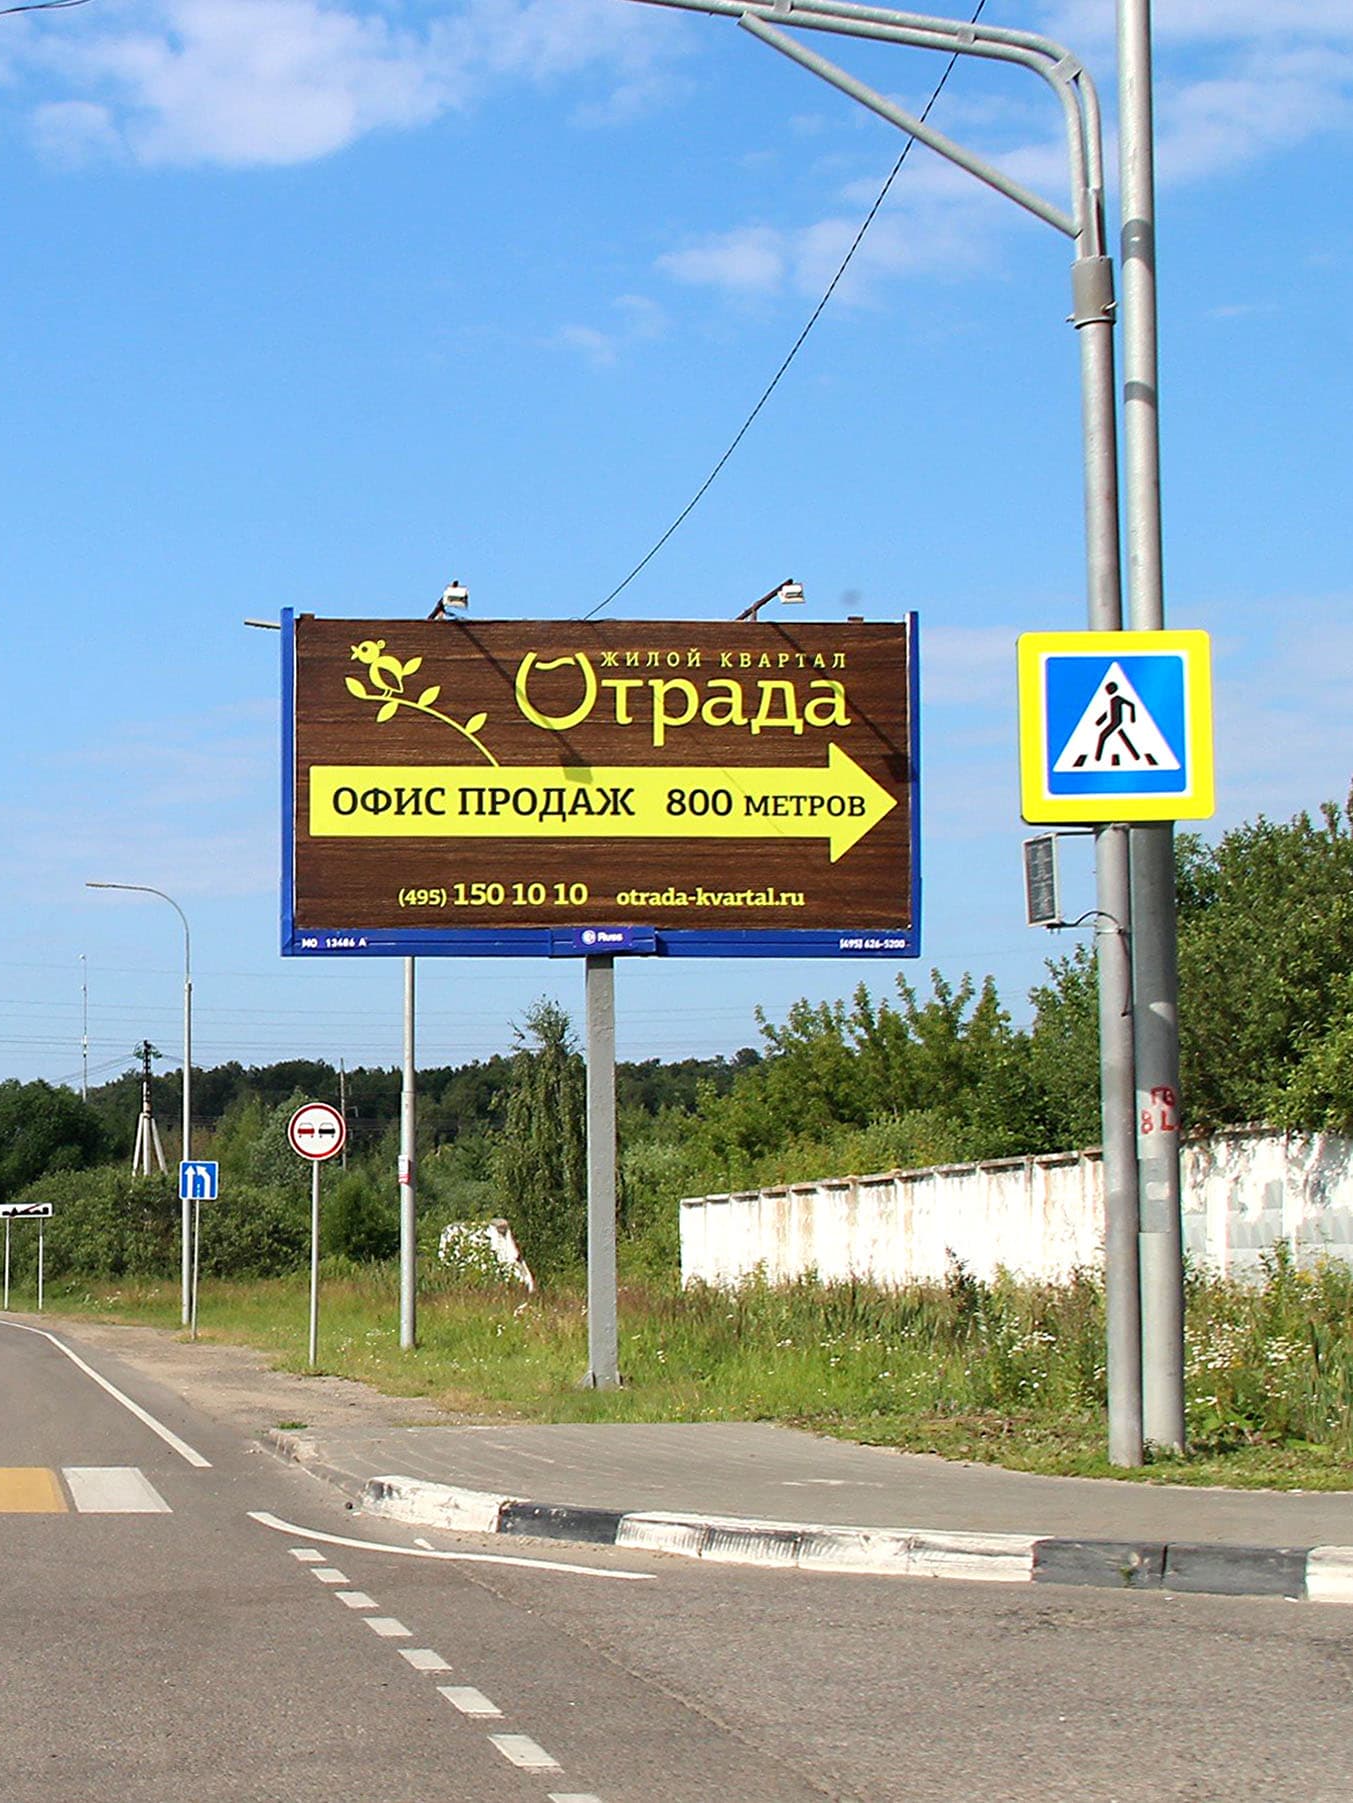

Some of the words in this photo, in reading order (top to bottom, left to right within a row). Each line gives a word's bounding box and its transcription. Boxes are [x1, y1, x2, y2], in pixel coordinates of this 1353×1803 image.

[600, 648, 701, 667] ЖИЛОЙ
[720, 652, 846, 669] КВАРТАЛ
[515, 651, 852, 747] Отрада
[332, 787, 446, 816] ОФИС
[458, 787, 636, 823] ПРОДАЖ
[666, 788, 733, 817] 800
[744, 795, 866, 818] МЕТРОВ
[398, 887, 447, 908] (495)
[453, 882, 505, 906] 150
[511, 882, 546, 906] 10
[553, 882, 588, 906] 10
[616, 886, 806, 909] otrada-kvartal.ru
